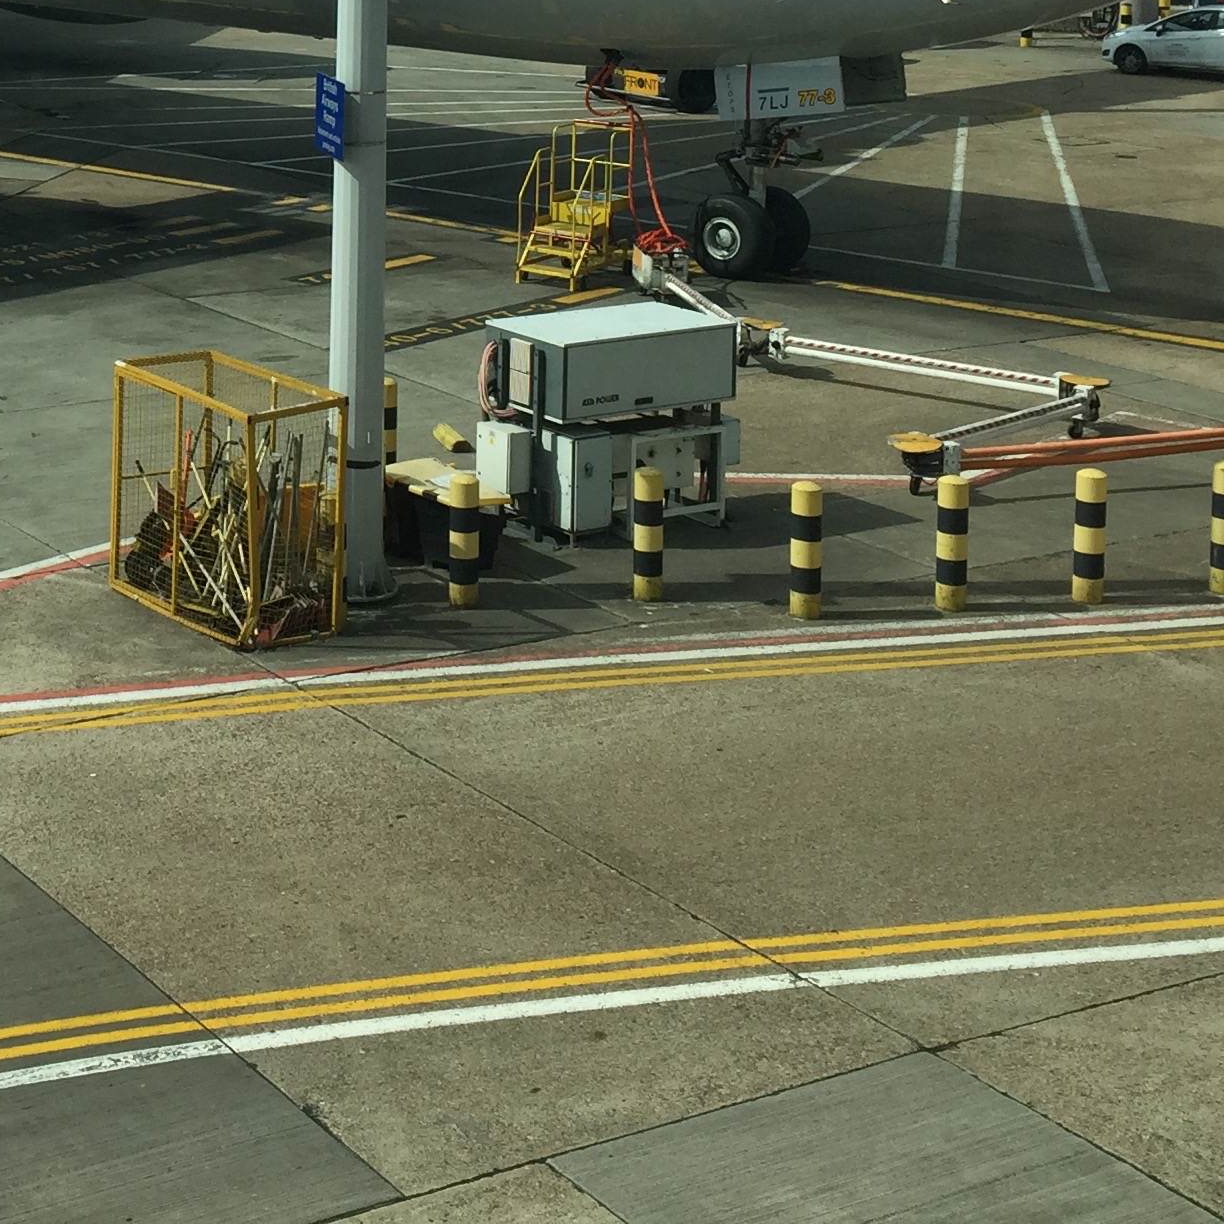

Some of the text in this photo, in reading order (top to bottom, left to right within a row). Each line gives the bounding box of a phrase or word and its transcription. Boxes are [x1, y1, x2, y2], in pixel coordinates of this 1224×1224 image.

[624, 75, 657, 91] FRONT
[758, 87, 836, 111] 7LJ 77-3
